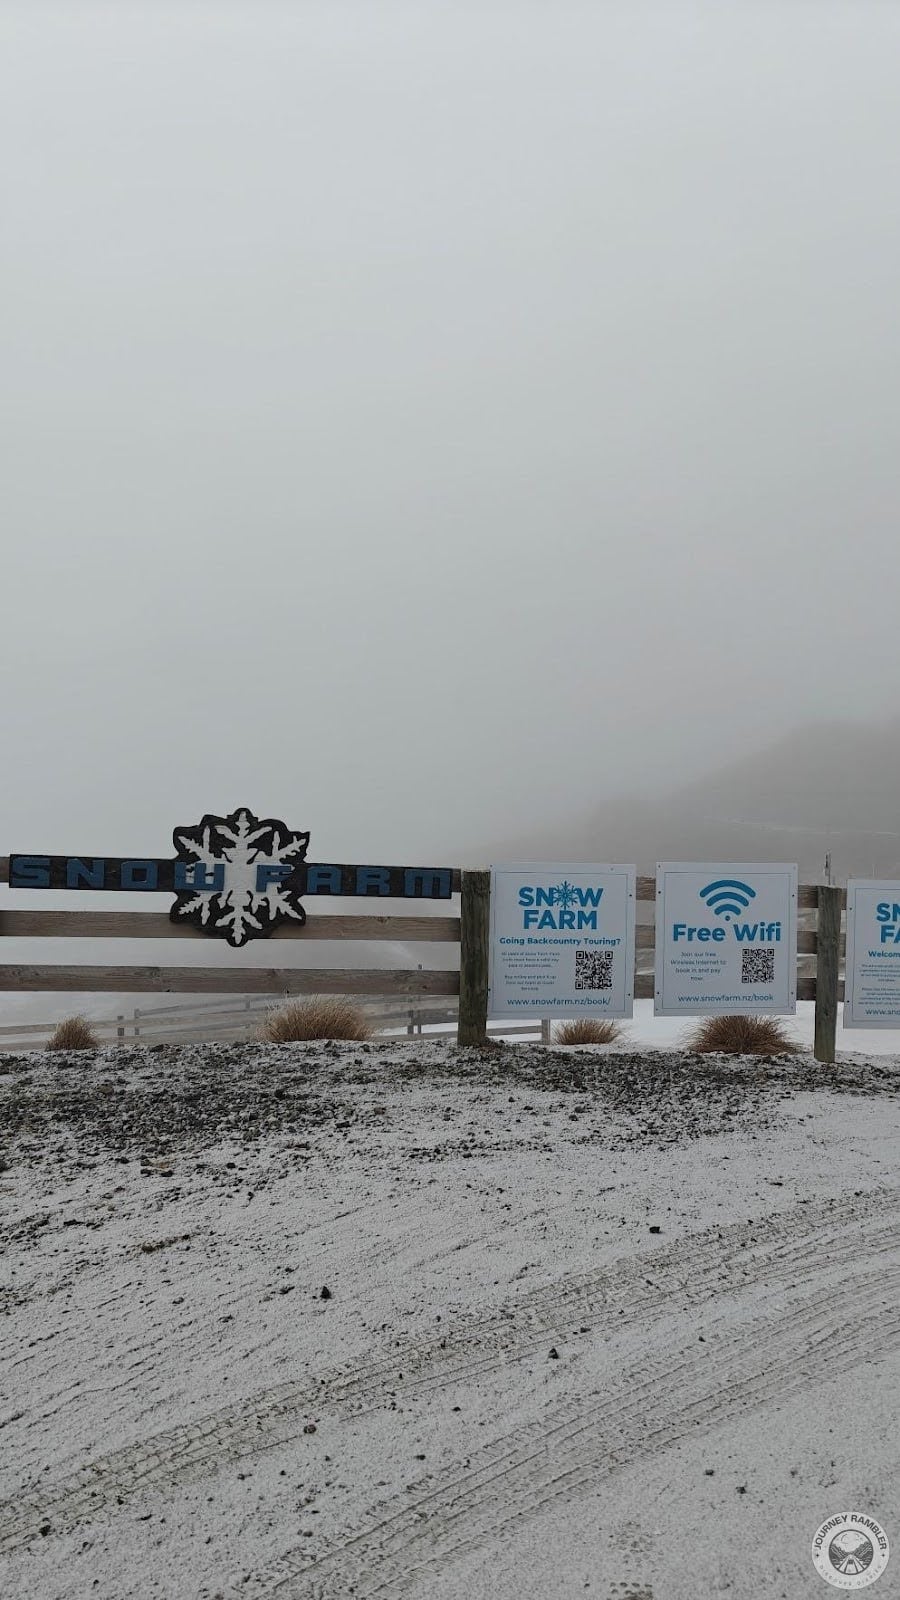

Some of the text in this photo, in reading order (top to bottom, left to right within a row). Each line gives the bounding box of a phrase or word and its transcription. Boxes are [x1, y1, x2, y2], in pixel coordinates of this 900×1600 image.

[12, 857, 451, 898] SNOW FARM
[523, 909, 597, 930] FARM
[673, 921, 781, 942] Free Wifi
[499, 937, 621, 947] Going Backcountry Touring?
[507, 997, 611, 1007] www.snowfarm.nz/book/
[678, 993, 774, 1004] www.snowfarm.nz/book
